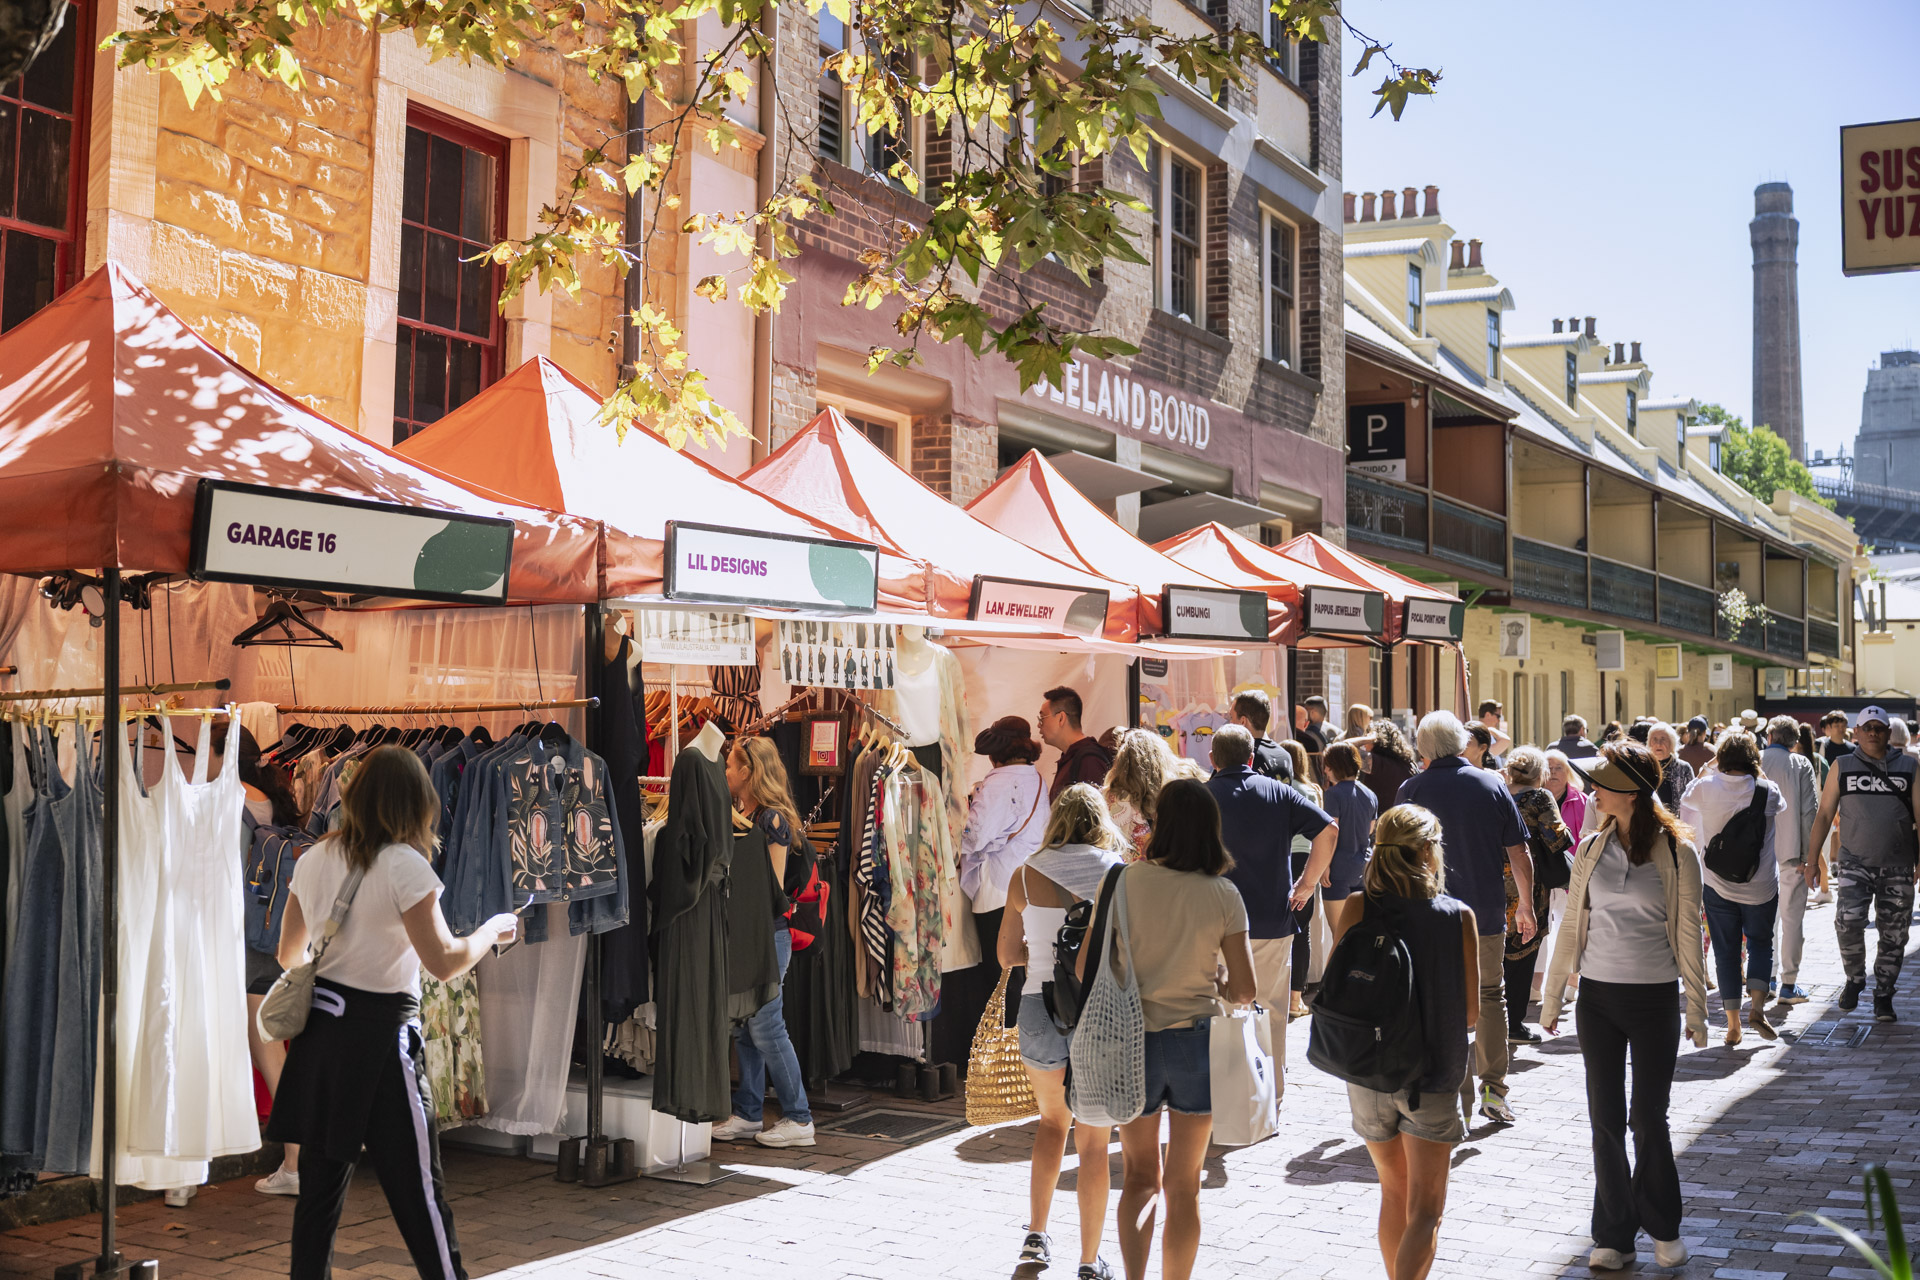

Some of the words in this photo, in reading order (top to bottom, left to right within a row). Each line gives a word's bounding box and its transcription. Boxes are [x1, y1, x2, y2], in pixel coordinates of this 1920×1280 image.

[1149, 390, 1210, 450] BOND
[227, 521, 314, 552] GARAGE
[317, 532, 337, 554] 16
[689, 553, 708, 571] LIL
[711, 555, 768, 577] DESIGNS
[985, 600, 1005, 616] LAN
[1005, 602, 1055, 620] JEWELLERY
[1176, 605, 1211, 619] CUMBUNGI
[1314, 603, 1334, 615] PAPPUS
[1334, 604, 1362, 618] JEWELLERY
[1410, 612, 1424, 623] FOCAL
[1424, 613, 1436, 624] POINT
[1435, 615, 1447, 625] HOME
